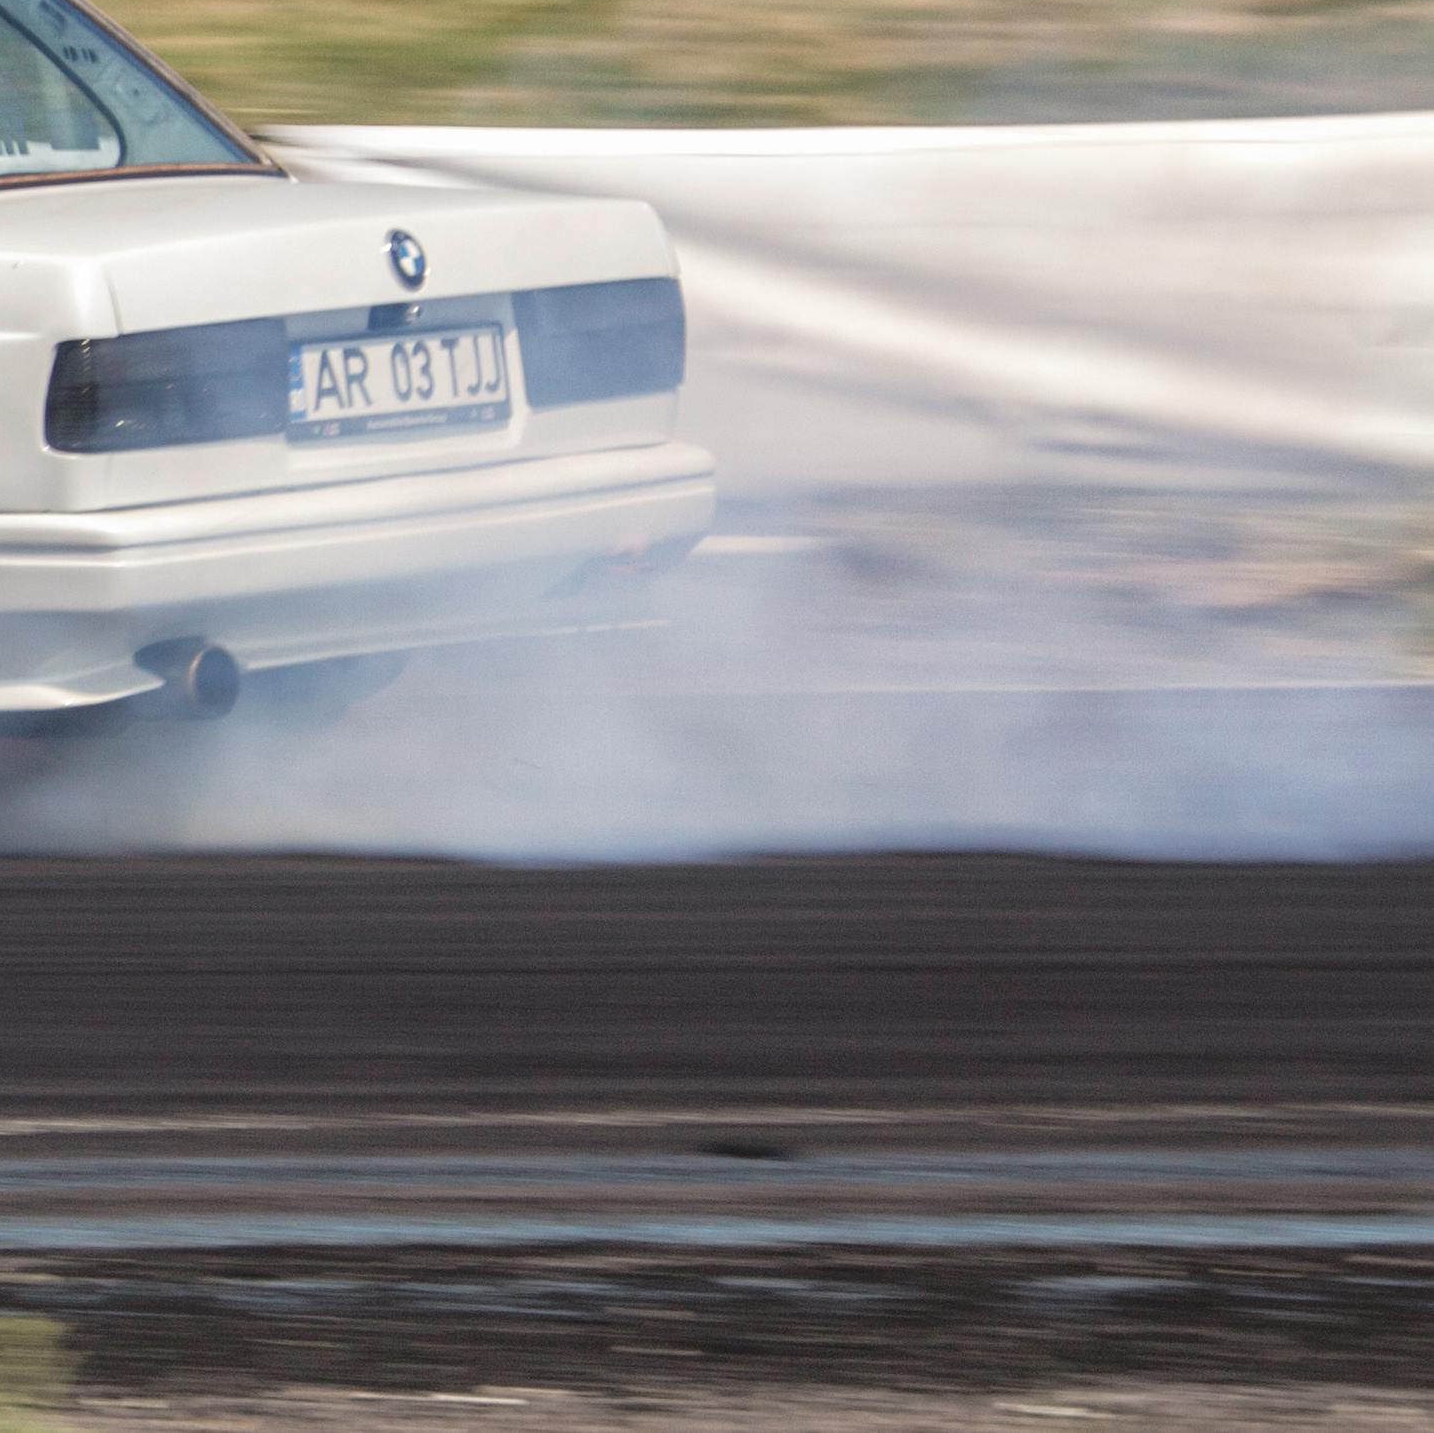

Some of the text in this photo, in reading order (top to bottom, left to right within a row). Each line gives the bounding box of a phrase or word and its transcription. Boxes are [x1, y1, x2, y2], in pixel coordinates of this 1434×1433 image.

[315, 334, 501, 411] AR 03 TJJ
